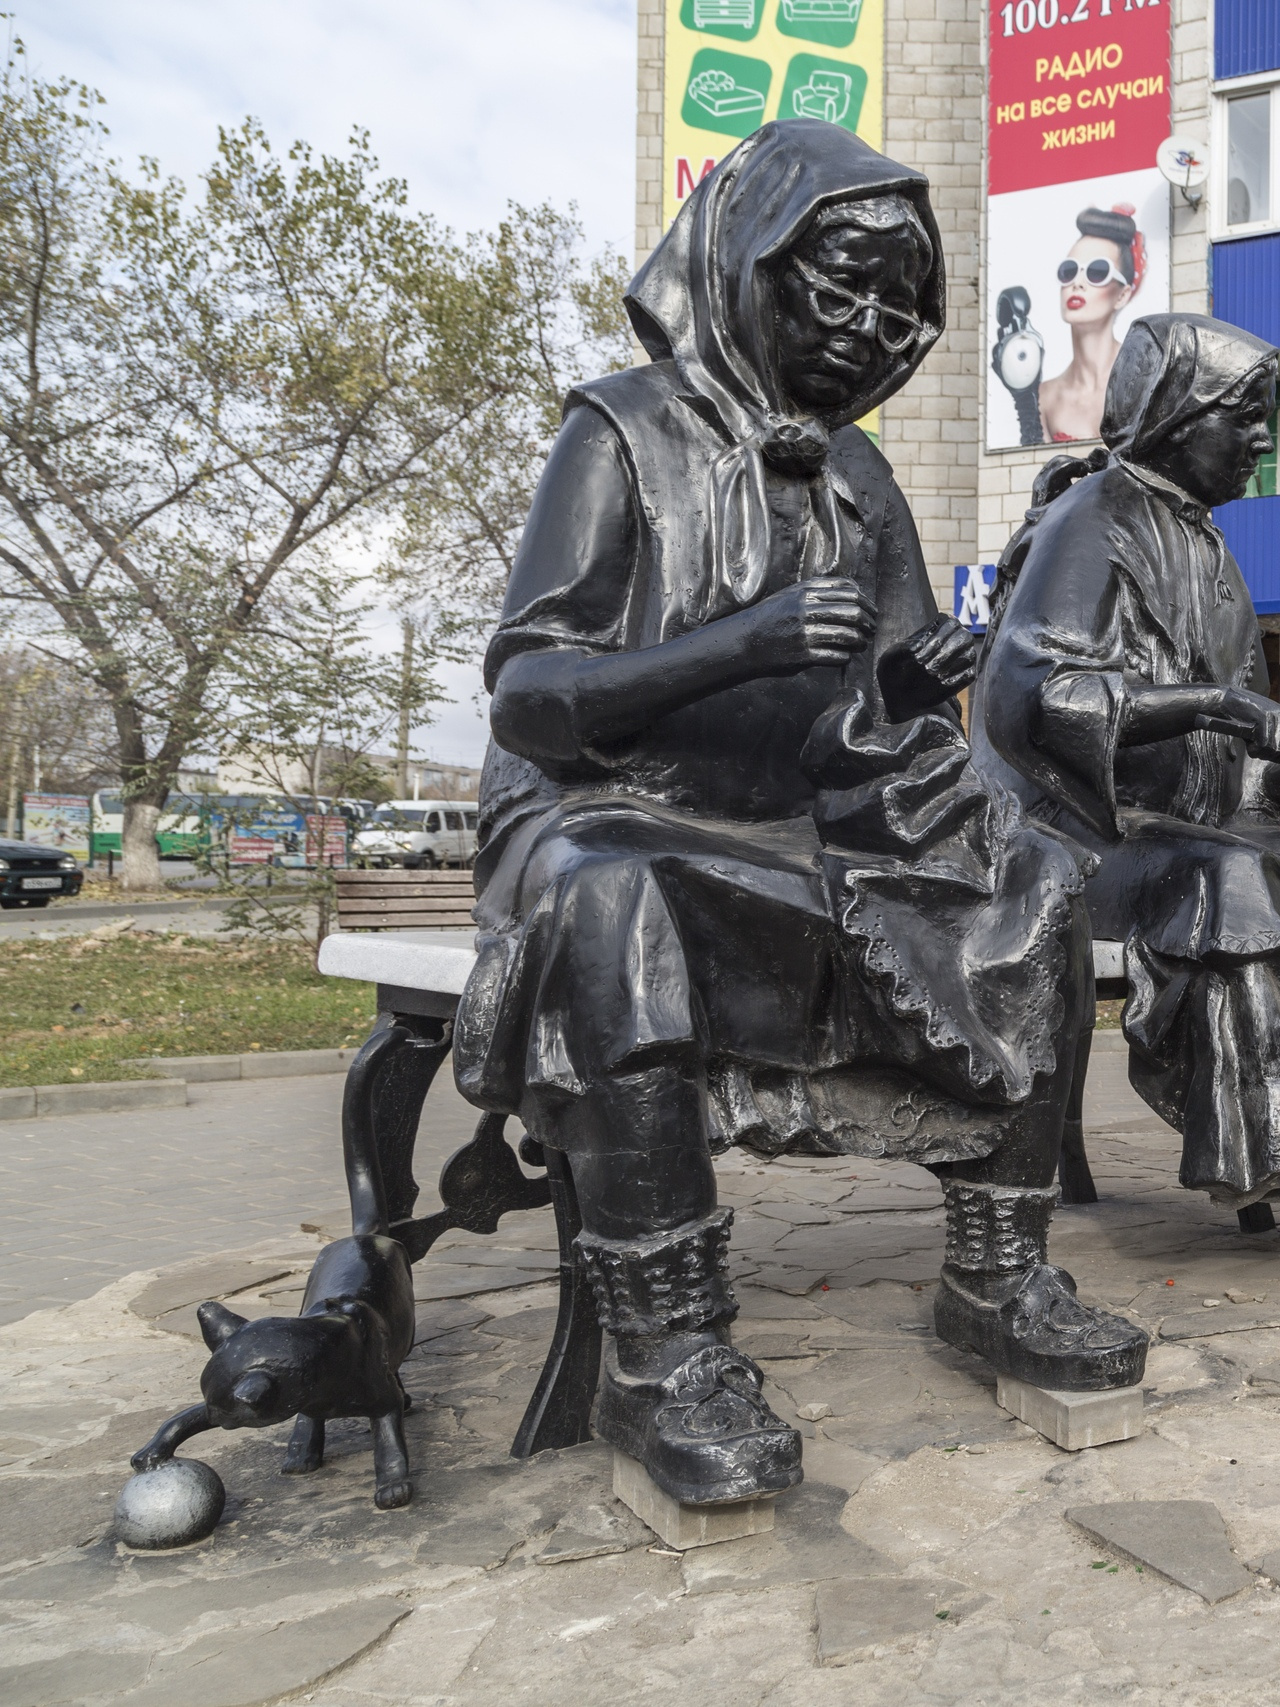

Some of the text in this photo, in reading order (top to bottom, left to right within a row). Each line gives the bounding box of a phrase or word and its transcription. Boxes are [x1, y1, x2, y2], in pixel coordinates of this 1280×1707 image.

[1000, 0, 1090, 37] 100.2
[1036, 43, 1123, 82] РАДИО
[996, 75, 1163, 124] на все случаи
[1041, 119, 1115, 151] жизни
